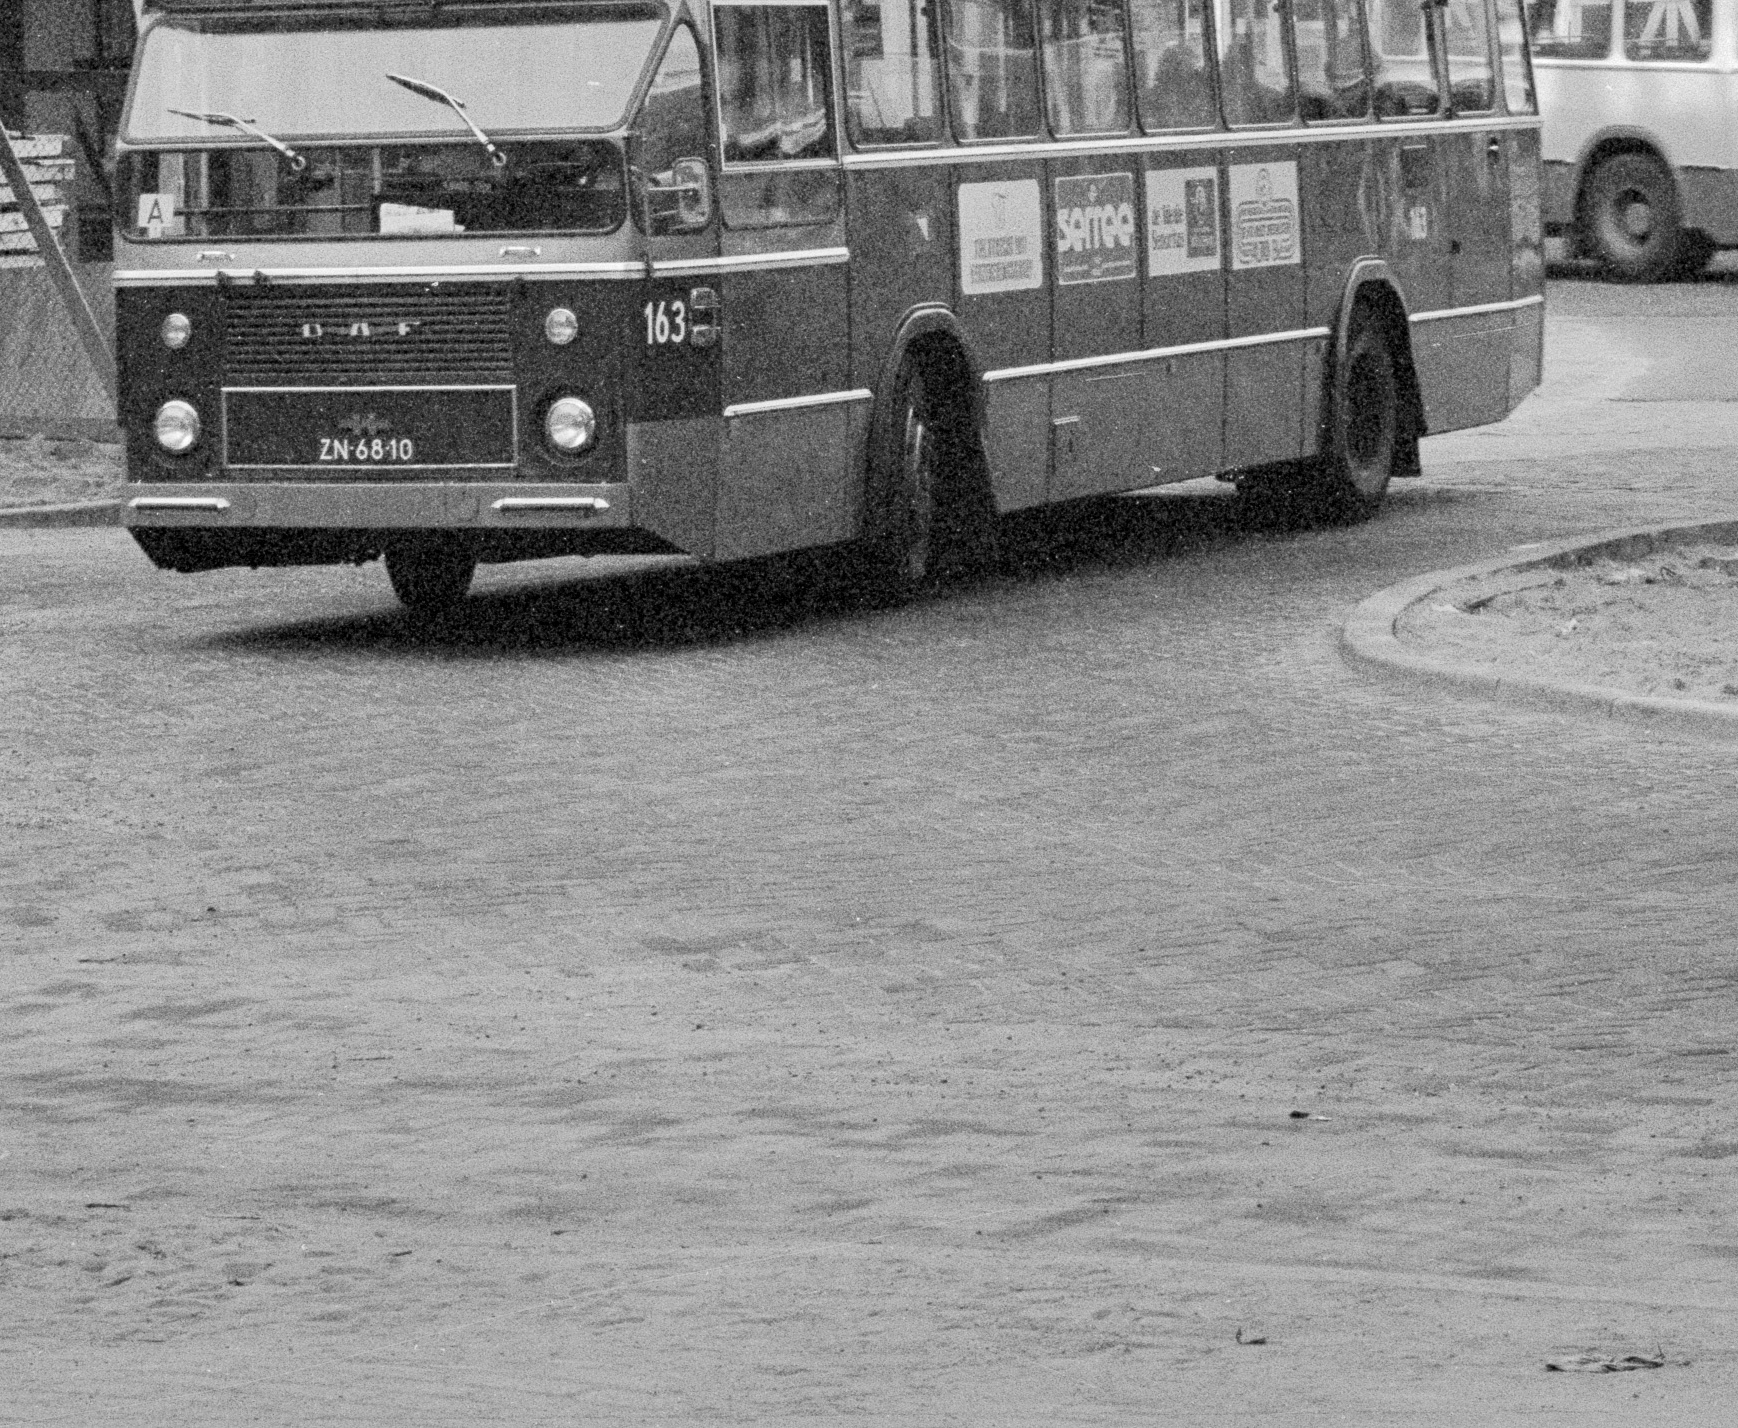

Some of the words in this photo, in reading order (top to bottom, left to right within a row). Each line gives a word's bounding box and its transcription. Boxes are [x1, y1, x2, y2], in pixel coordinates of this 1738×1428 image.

[147, 198, 164, 225] A
[644, 300, 686, 345] 163
[319, 437, 413, 461] ZN-68-10
